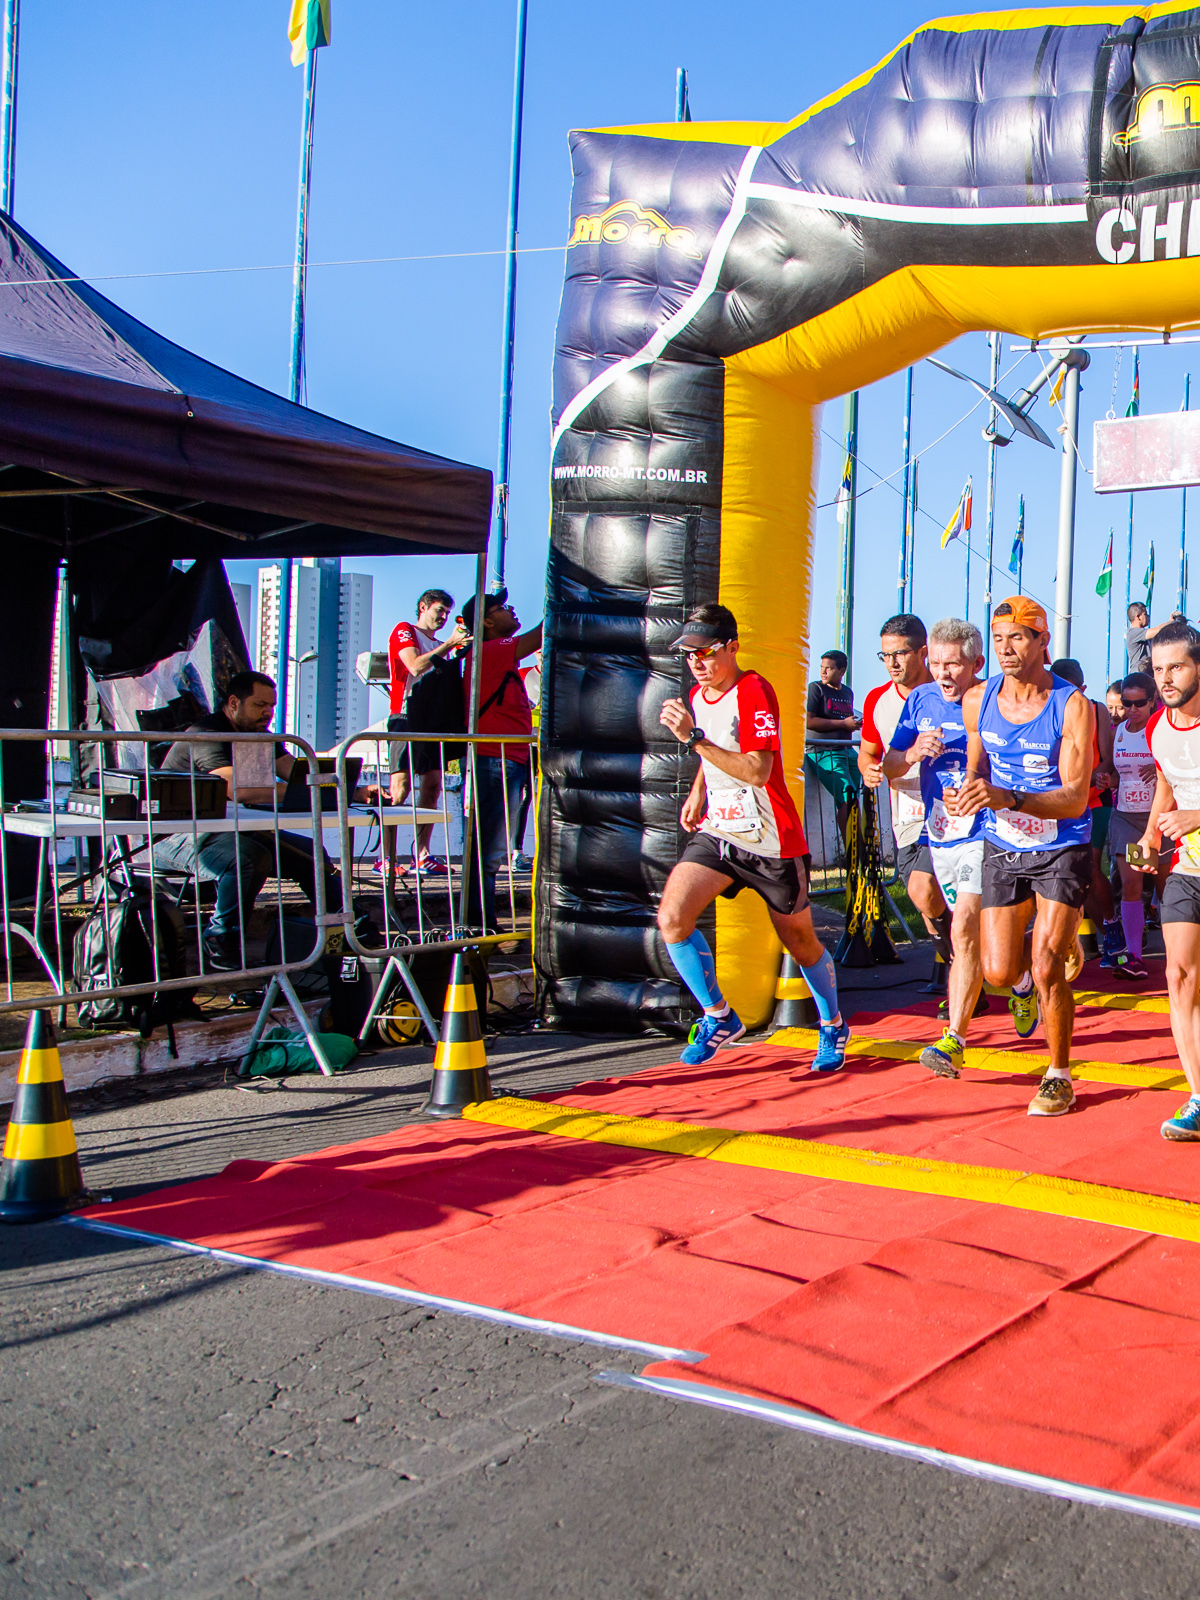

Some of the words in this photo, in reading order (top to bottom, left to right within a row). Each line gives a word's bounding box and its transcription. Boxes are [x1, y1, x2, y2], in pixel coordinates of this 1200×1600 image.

[554, 465, 708, 484] WWW.MORRO-MT.COM.BR
[1125, 791, 1149, 802] 546
[1008, 818, 1043, 834] 528
